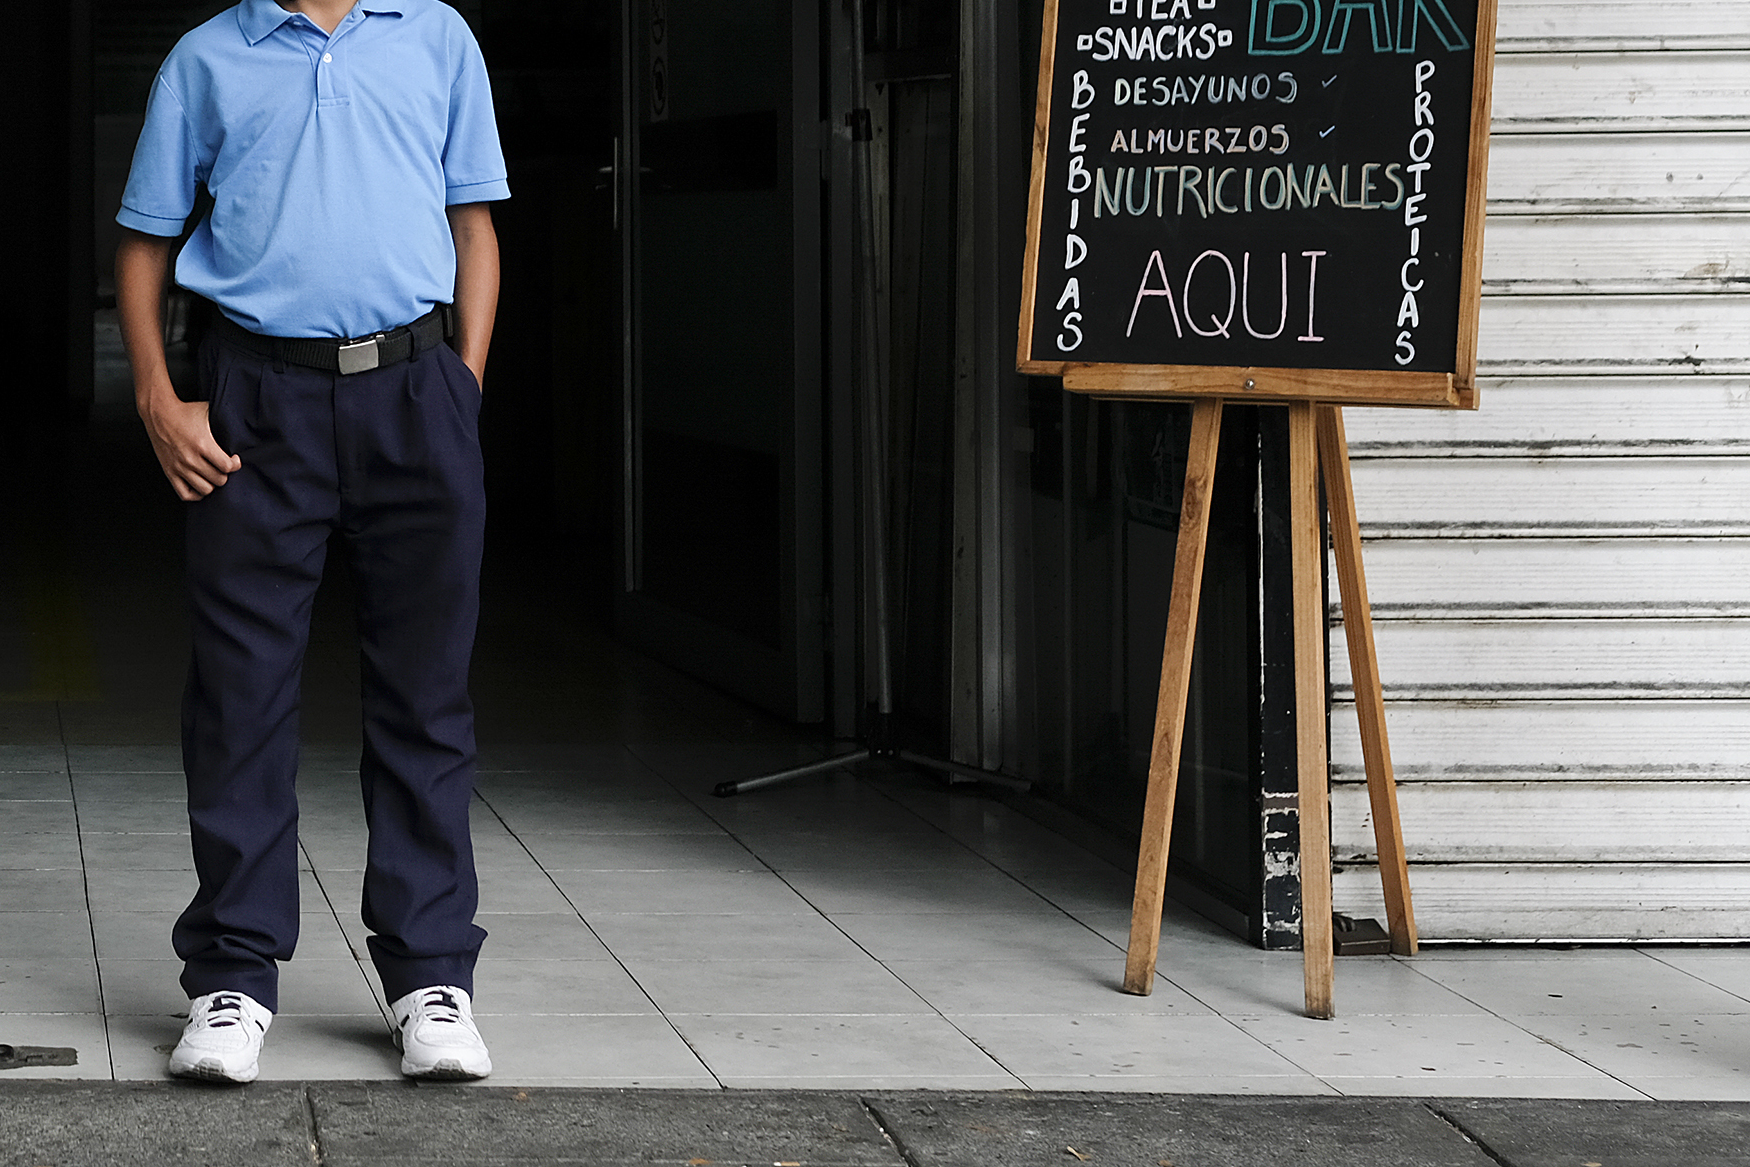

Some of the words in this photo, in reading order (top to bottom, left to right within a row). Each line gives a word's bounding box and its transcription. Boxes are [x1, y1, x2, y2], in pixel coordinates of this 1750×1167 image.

[1092, 25, 1218, 62] SNACKS
[1113, 71, 1298, 107] DESAYUNOS
[1110, 124, 1290, 156] ALMUERZOS
[1055, 69, 1096, 353] BEBIDAS
[1093, 163, 1407, 220] NUTRICIONALES
[1394, 60, 1437, 365] PROTEICAS
[1126, 249, 1327, 343] AQUI
